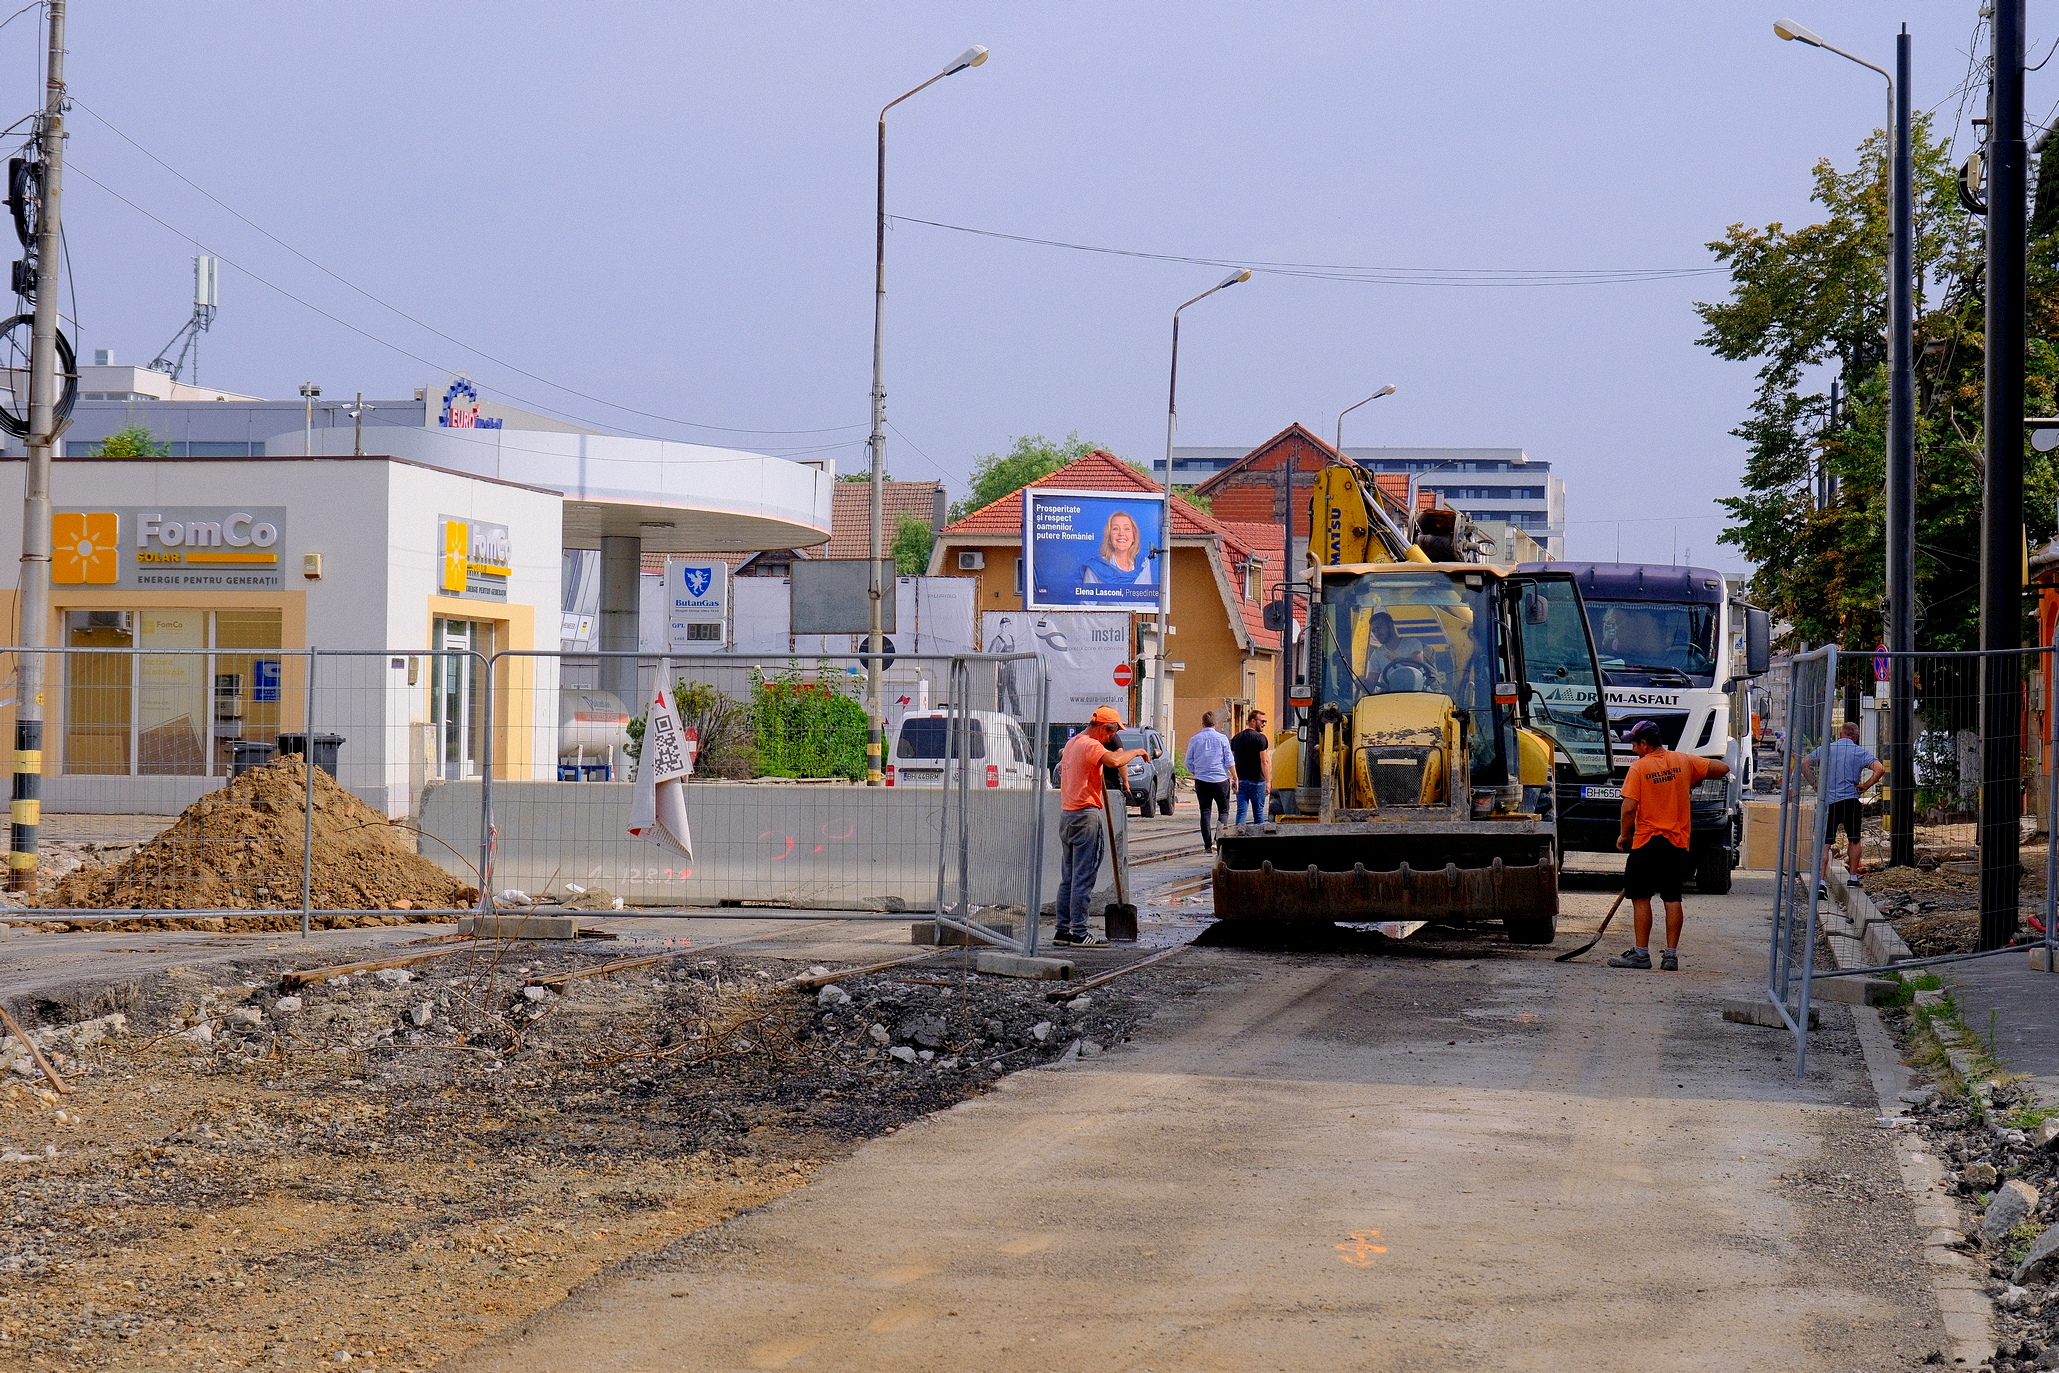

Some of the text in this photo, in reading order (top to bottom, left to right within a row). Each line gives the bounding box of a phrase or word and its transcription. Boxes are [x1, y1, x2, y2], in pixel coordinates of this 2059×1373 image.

[449, 408, 475, 429] EURO
[1036, 504, 1081, 514] Prosperitate
[1036, 514, 1072, 524] și respect
[136, 512, 277, 548] FomCo
[1036, 523, 1074, 532] oamenilor,
[1036, 532, 1095, 541] putere României
[472, 524, 512, 561] FomCo
[136, 552, 181, 563] SOLAR
[137, 576, 278, 587] ENERGIE PENTRU GENERAȚII
[1075, 588, 1159, 597] Elena Lasconi, Președinte
[156, 620, 183, 629] FomCo
[1091, 626, 1125, 642] instal
[1069, 728, 1075, 737] P
[1586, 787, 1601, 798] BH
